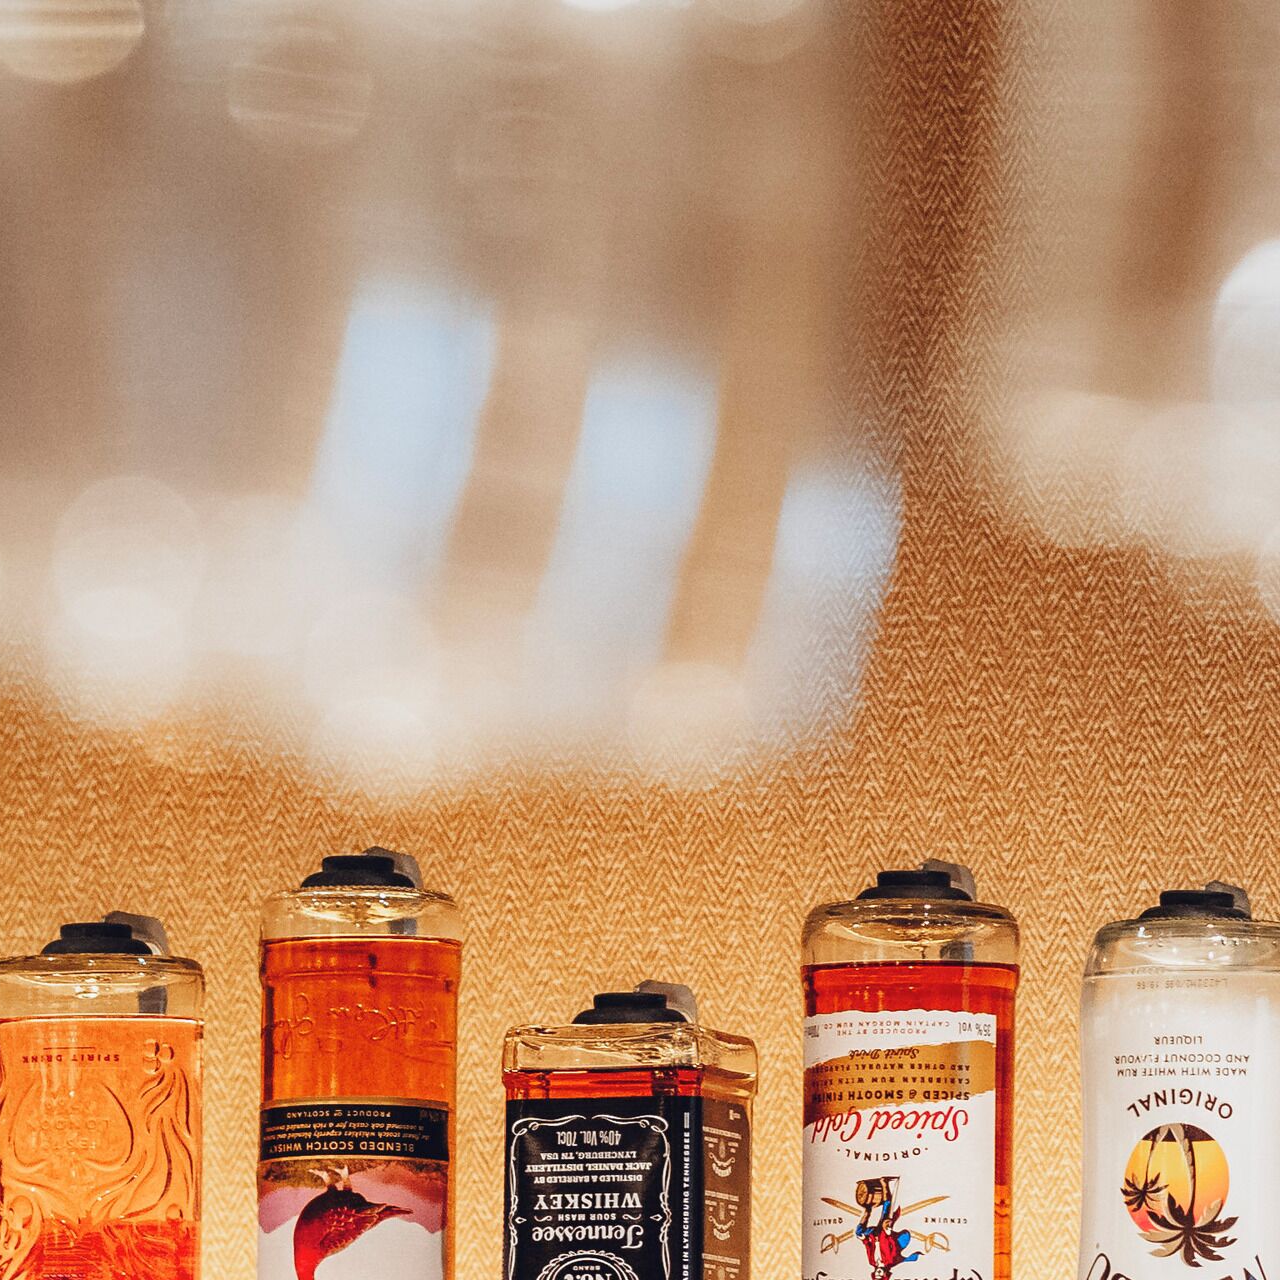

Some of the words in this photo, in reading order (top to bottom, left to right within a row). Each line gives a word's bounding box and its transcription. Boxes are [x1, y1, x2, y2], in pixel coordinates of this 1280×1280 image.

[906, 1020, 950, 1028] CAPTAIN
[1153, 1035, 1203, 1045] LIQUEUR
[22, 1054, 62, 1063] DRINK
[71, 1054, 120, 1062] SPIRIT
[848, 1048, 882, 1060] Drink
[884, 1047, 919, 1060] Spirit
[1163, 1053, 1221, 1063] COCONUT
[1225, 1054, 1250, 1063] AND
[1113, 1054, 1160, 1064] FLAVOUR
[1117, 1068, 1138, 1077] RUM
[1141, 1068, 1176, 1077] WHITE
[1181, 1067, 1211, 1077] WITH
[1215, 1067, 1247, 1077] MADE
[902, 1076, 970, 1085] CARIBBEAN
[847, 1090, 904, 1100] SMOOTH
[922, 1090, 970, 1101] SPICED
[1126, 1088, 1233, 1119] ORIGINAL
[286, 1110, 330, 1119] SCOTLAND
[312, 1122, 327, 1130] rich
[811, 1106, 862, 1144] Gold
[867, 1106, 969, 1142] Spiced
[344, 1130, 375, 1138] whiskies
[599, 1130, 621, 1146] 40%
[306, 1141, 354, 1151] SCOTCH
[359, 1141, 414, 1152] BLENDED
[540, 1152, 559, 1161] USA
[561, 1152, 574, 1160] TN
[576, 1150, 637, 1160] LYNCHBURG,
[845, 1147, 921, 1162] ORIGINAL
[525, 1163, 584, 1173] DISTILLERY
[585, 1162, 624, 1172] DANIEL
[625, 1162, 652, 1172] JACK
[533, 1176, 546, 1184] BY
[546, 1175, 590, 1184] BARRELED
[600, 1174, 643, 1183] DISTILLED
[533, 1192, 642, 1210] WHISKEY
[558, 1213, 586, 1221] MASH
[589, 1213, 616, 1221] SOUR
[812, 1217, 843, 1226] QUALITY
[532, 1224, 644, 1249] Tennessee
[682, 1251, 689, 1261] IN
